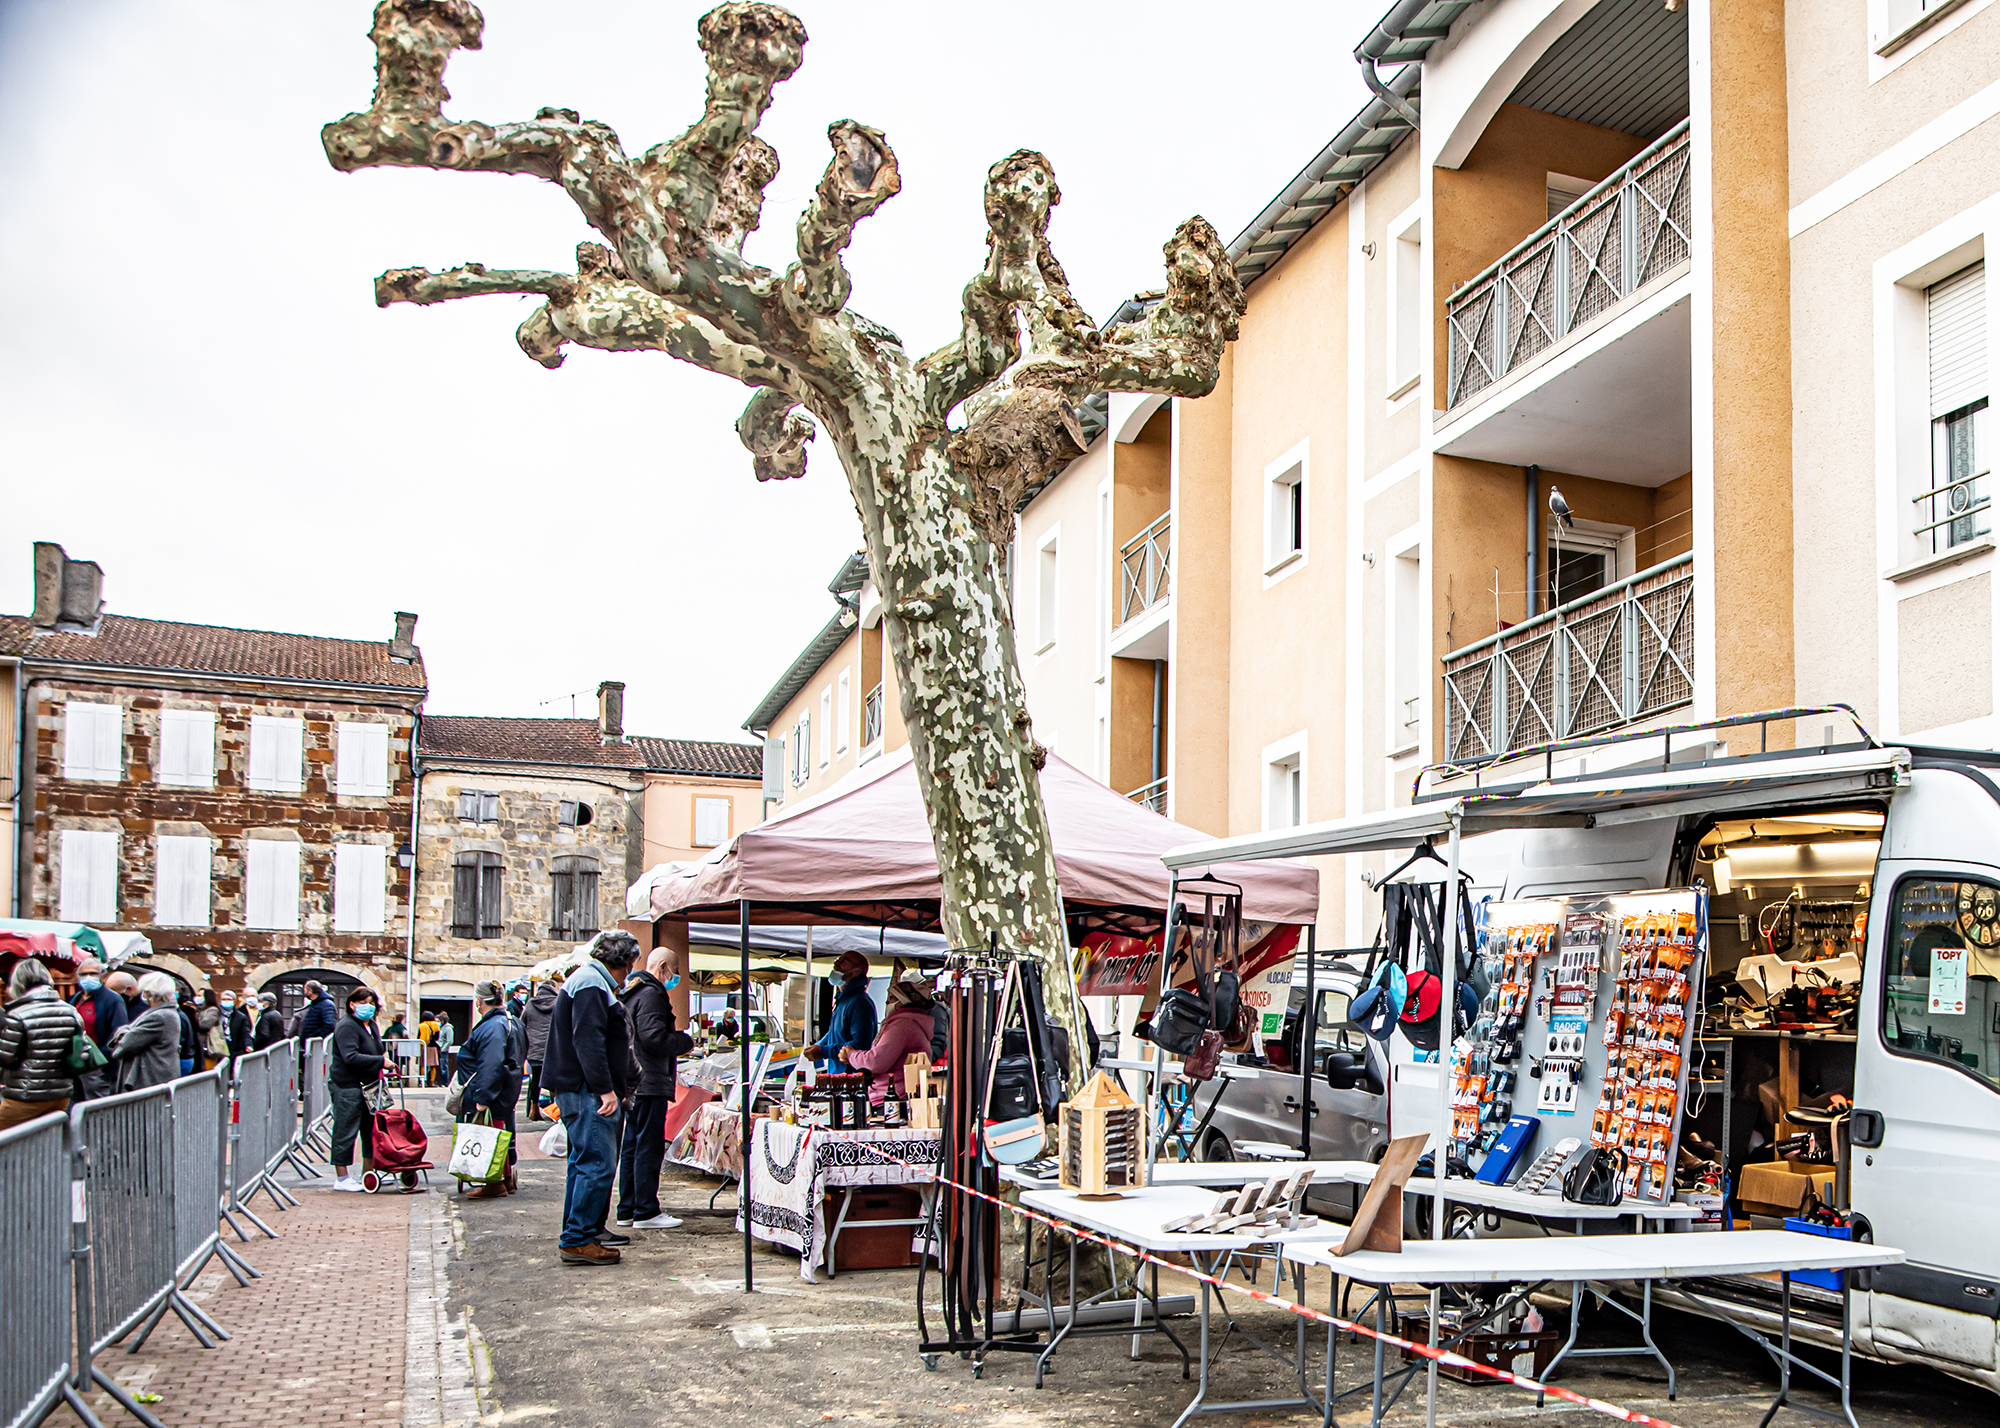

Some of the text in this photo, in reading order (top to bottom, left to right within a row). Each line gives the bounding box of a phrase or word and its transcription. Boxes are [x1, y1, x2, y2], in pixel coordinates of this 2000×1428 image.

[1937, 951, 1962, 960] TOPY
[1553, 1021, 1582, 1031] BADGE
[460, 1139, 482, 1158] 60
